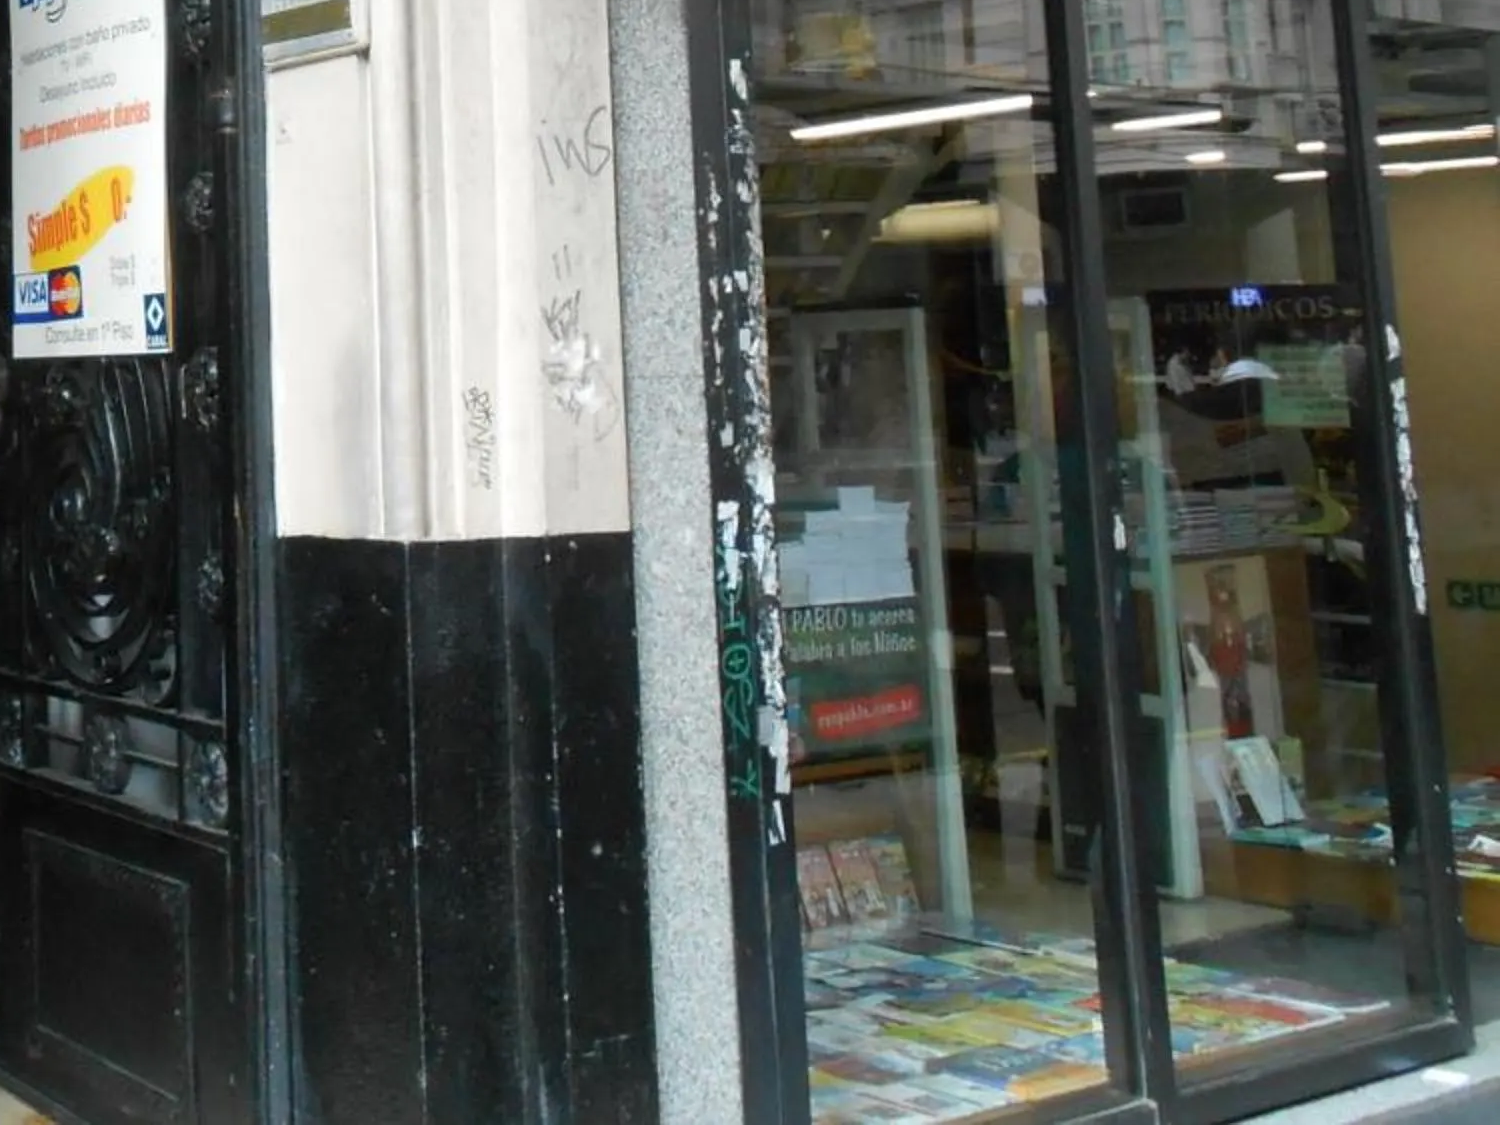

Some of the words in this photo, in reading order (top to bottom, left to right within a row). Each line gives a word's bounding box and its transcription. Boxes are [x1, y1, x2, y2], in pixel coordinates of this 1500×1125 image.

[27, 198, 77, 257] Simple
[18, 278, 48, 305] VISA
[792, 606, 847, 633] PABLO
